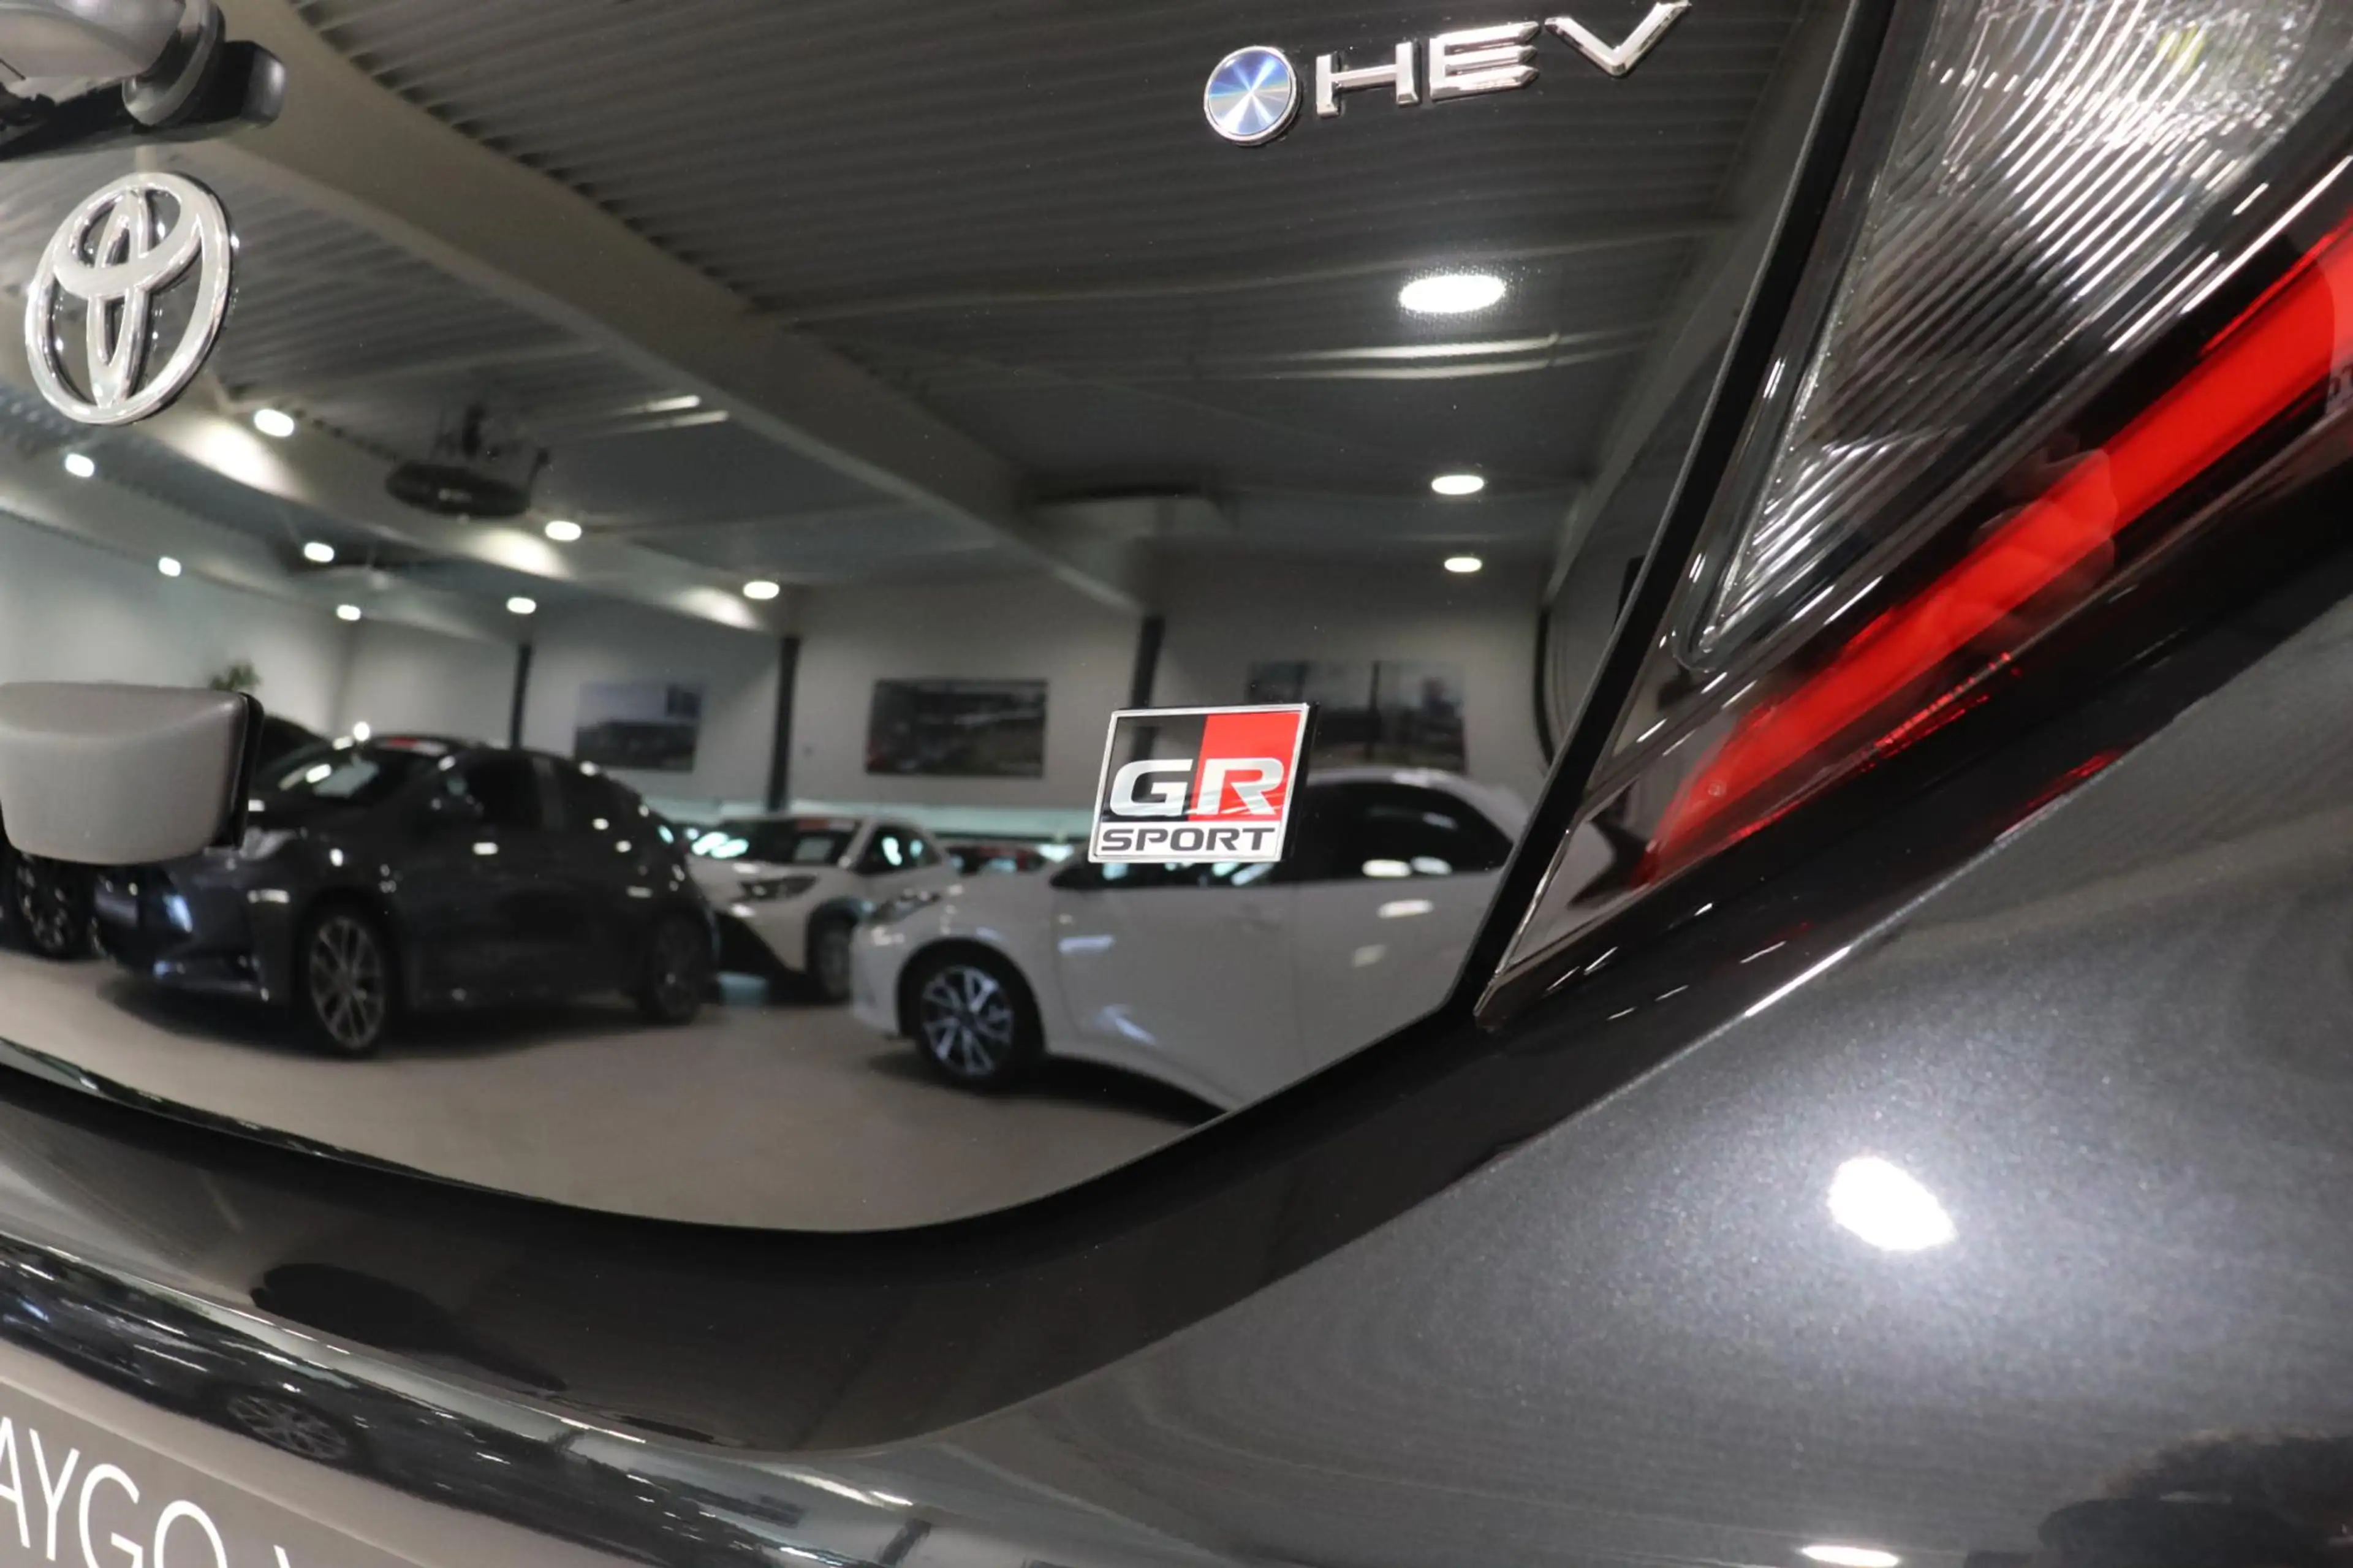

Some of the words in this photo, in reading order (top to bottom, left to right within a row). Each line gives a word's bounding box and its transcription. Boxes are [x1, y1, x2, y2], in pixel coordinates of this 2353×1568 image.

[1316, 1, 1691, 118] HEV
[1110, 757, 1284, 816] GR
[1101, 827, 1275, 852] SPORT
